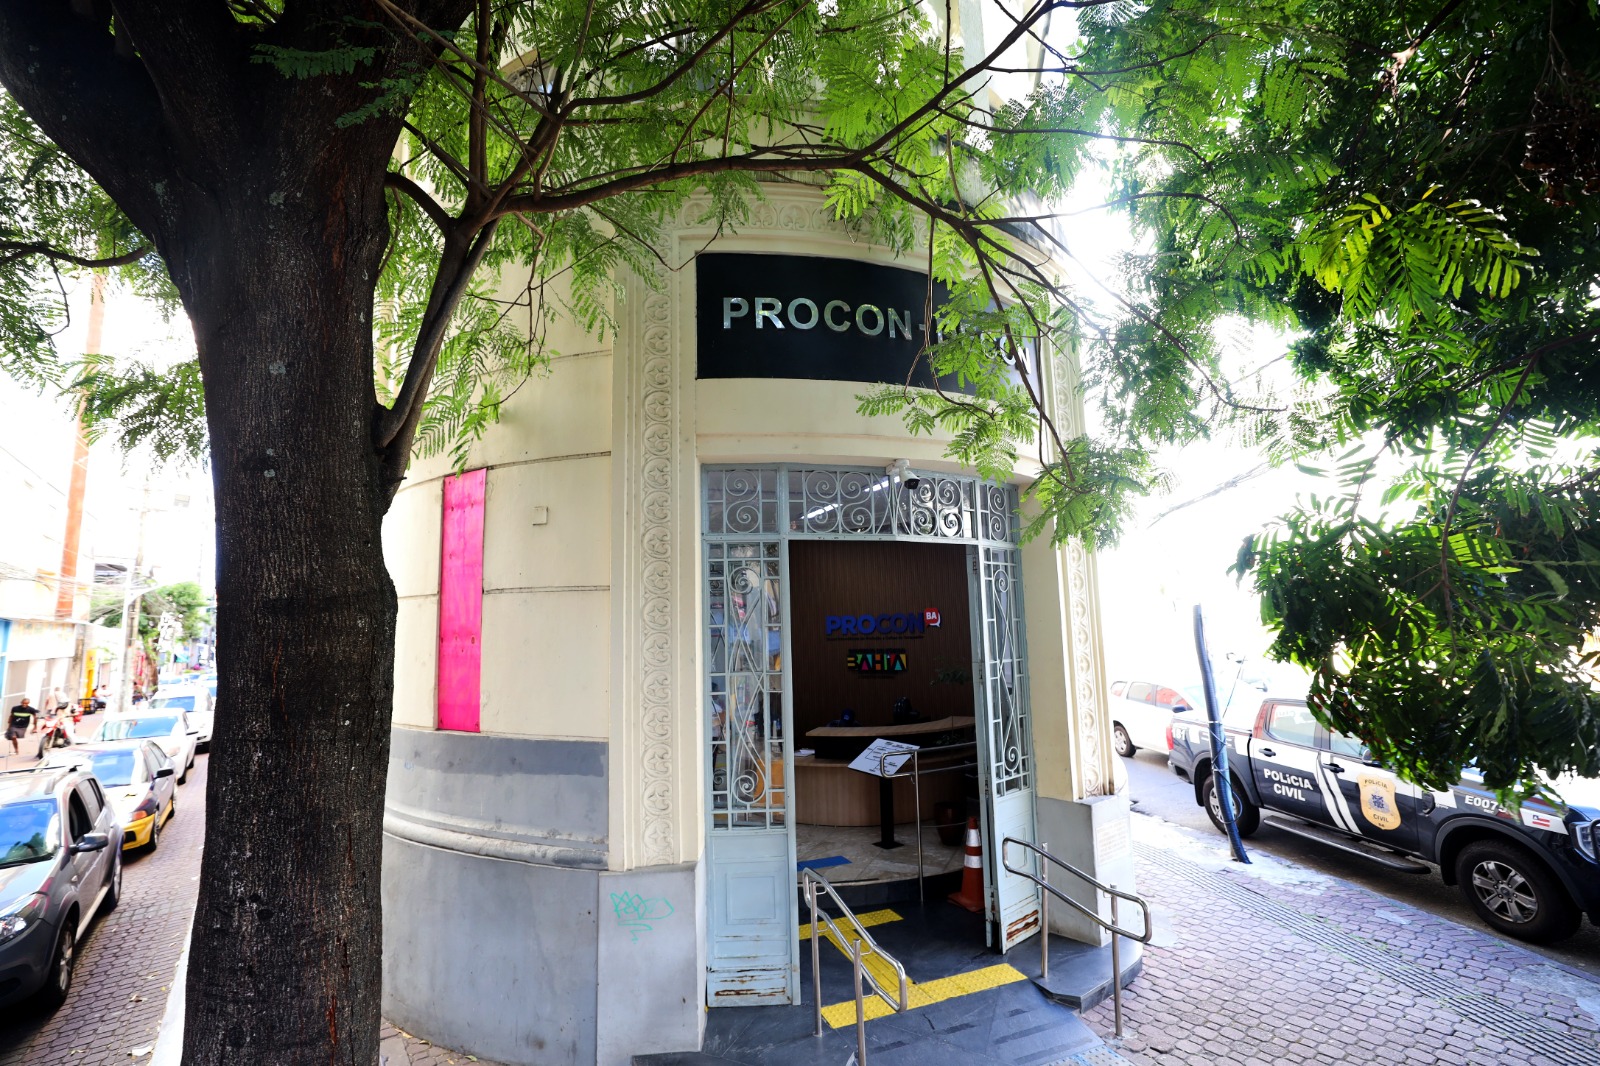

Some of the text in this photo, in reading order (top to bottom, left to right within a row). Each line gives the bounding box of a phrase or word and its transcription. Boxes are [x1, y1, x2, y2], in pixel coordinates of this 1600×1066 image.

[826, 612, 937, 634] PROCON BA
[1273, 783, 1306, 801] CIVIL
[1373, 813, 1389, 822] CIVIL
